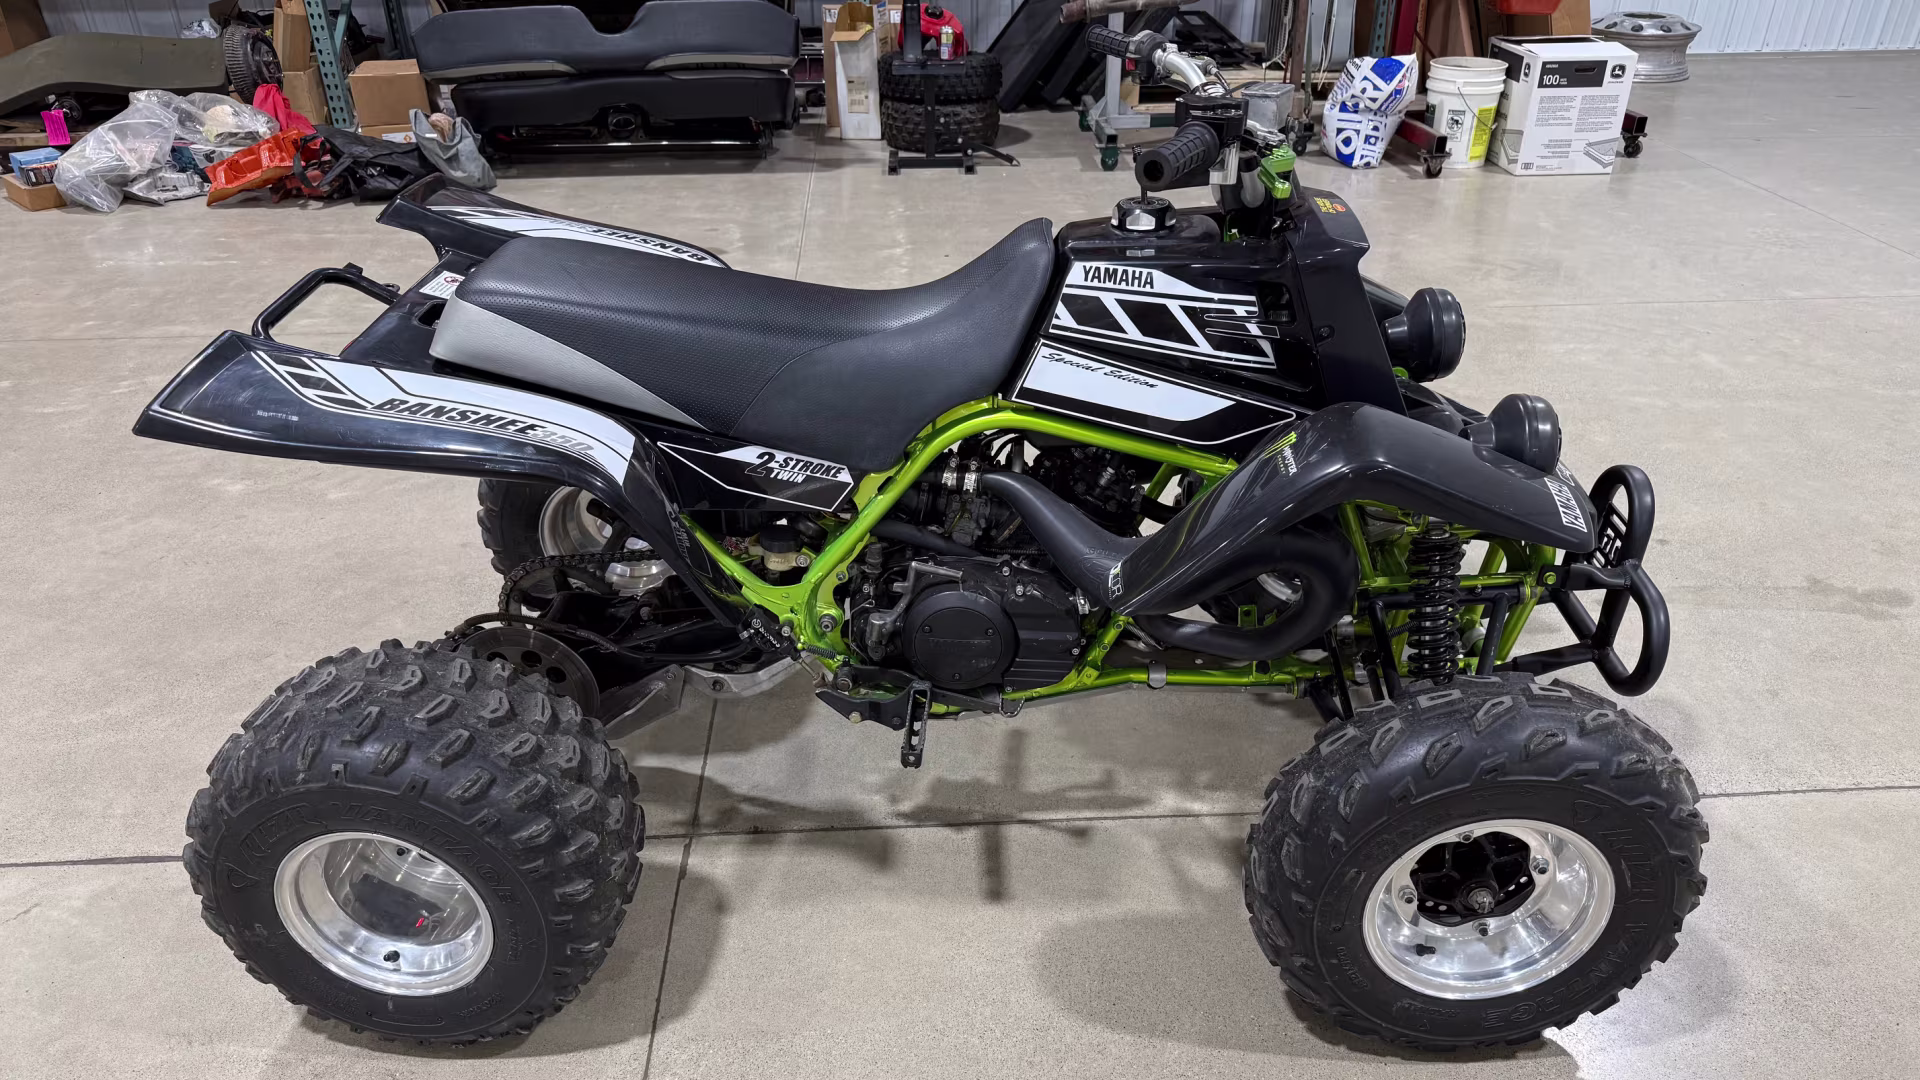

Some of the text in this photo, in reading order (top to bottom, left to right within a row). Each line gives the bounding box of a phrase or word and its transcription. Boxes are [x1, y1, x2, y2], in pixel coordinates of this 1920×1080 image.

[1542, 74, 1560, 86] 100
[1082, 264, 1155, 290] YAMAHA
[1041, 352, 1159, 390] Special Edition
[372, 397, 546, 437] BANSHEE
[745, 451, 846, 479] 2-STROKE
[769, 468, 807, 484] TWIN
